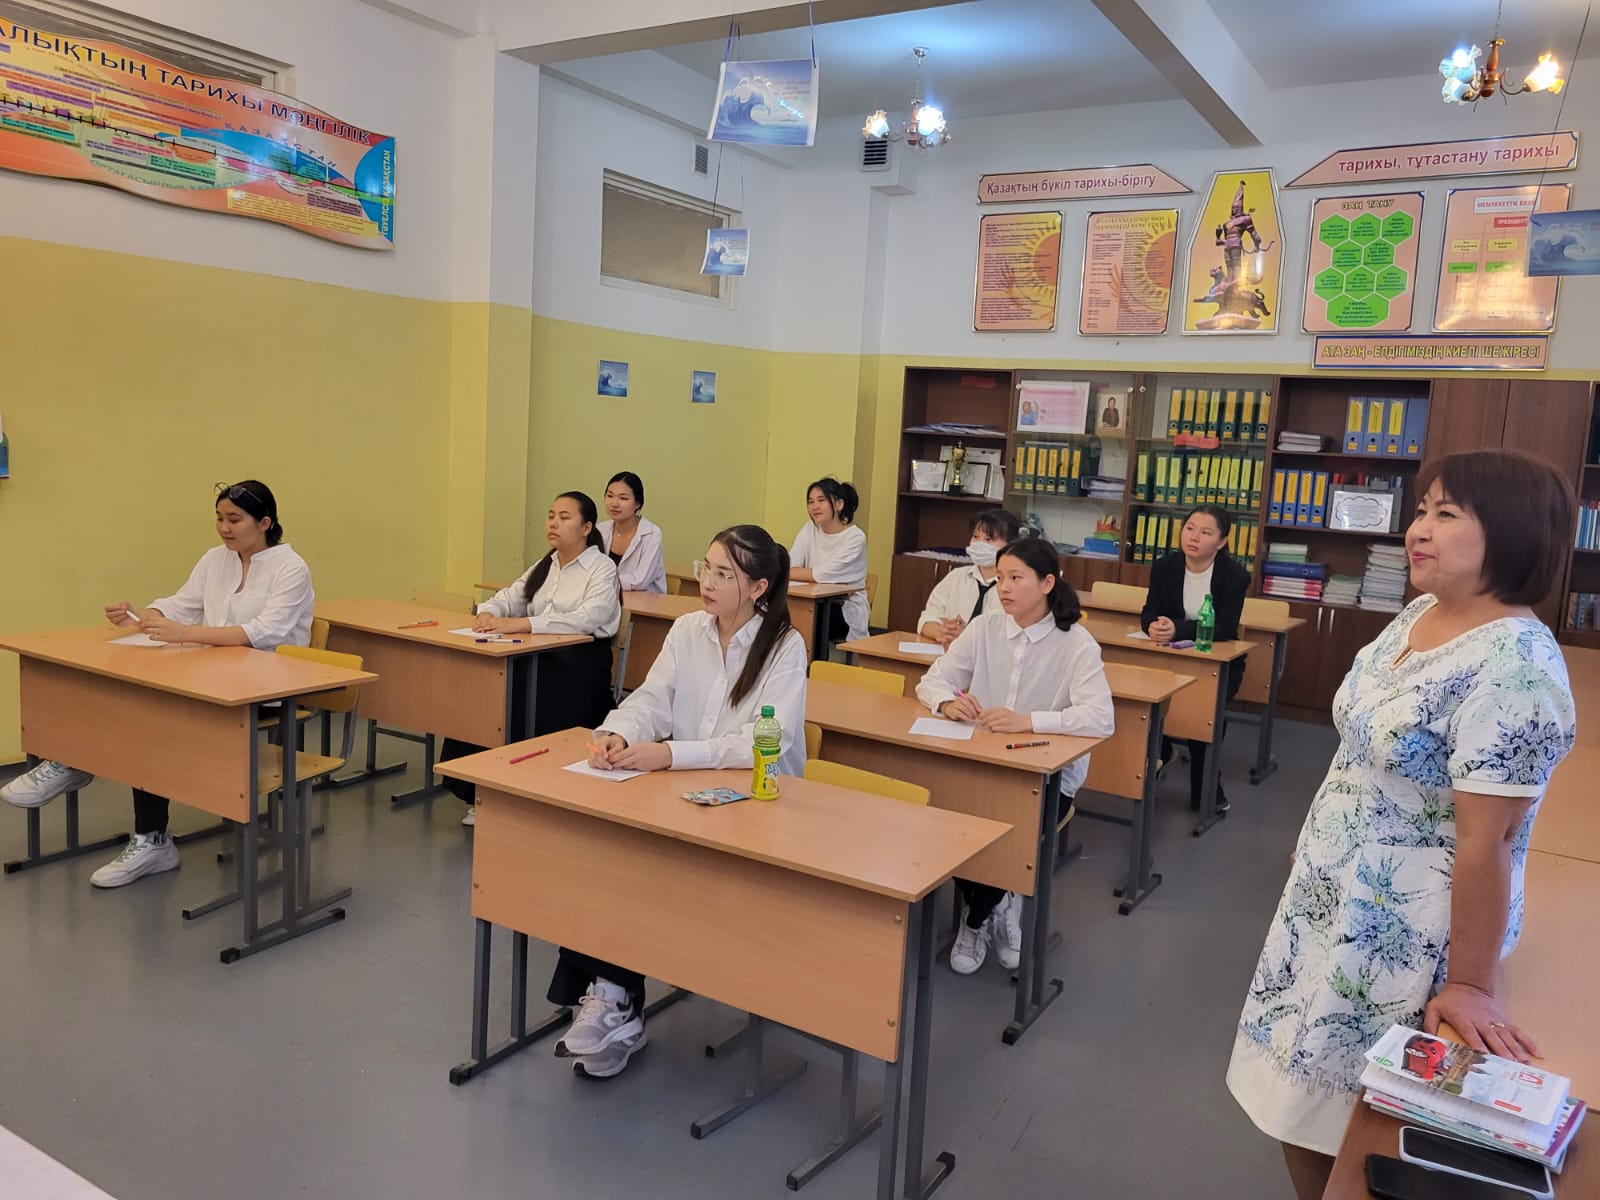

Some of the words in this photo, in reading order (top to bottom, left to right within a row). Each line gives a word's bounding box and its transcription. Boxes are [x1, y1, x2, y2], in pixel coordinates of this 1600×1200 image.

[0, 25, 147, 81] ЛЫҚТЫҢ
[156, 68, 263, 112] ТАРИХЫ
[271, 103, 370, 145] МӘҢГІЛІК
[1339, 157, 1401, 173] тарихы,
[1407, 151, 1489, 170] тұтастану
[1494, 145, 1559, 162] тарихы
[987, 179, 1038, 195] Қазақтың
[1042, 176, 1071, 191] бүкіл
[1075, 174, 1157, 190] тарихы-бірігу
[1321, 346, 1342, 358] АТА
[1344, 346, 1365, 358] ЗАҢ
